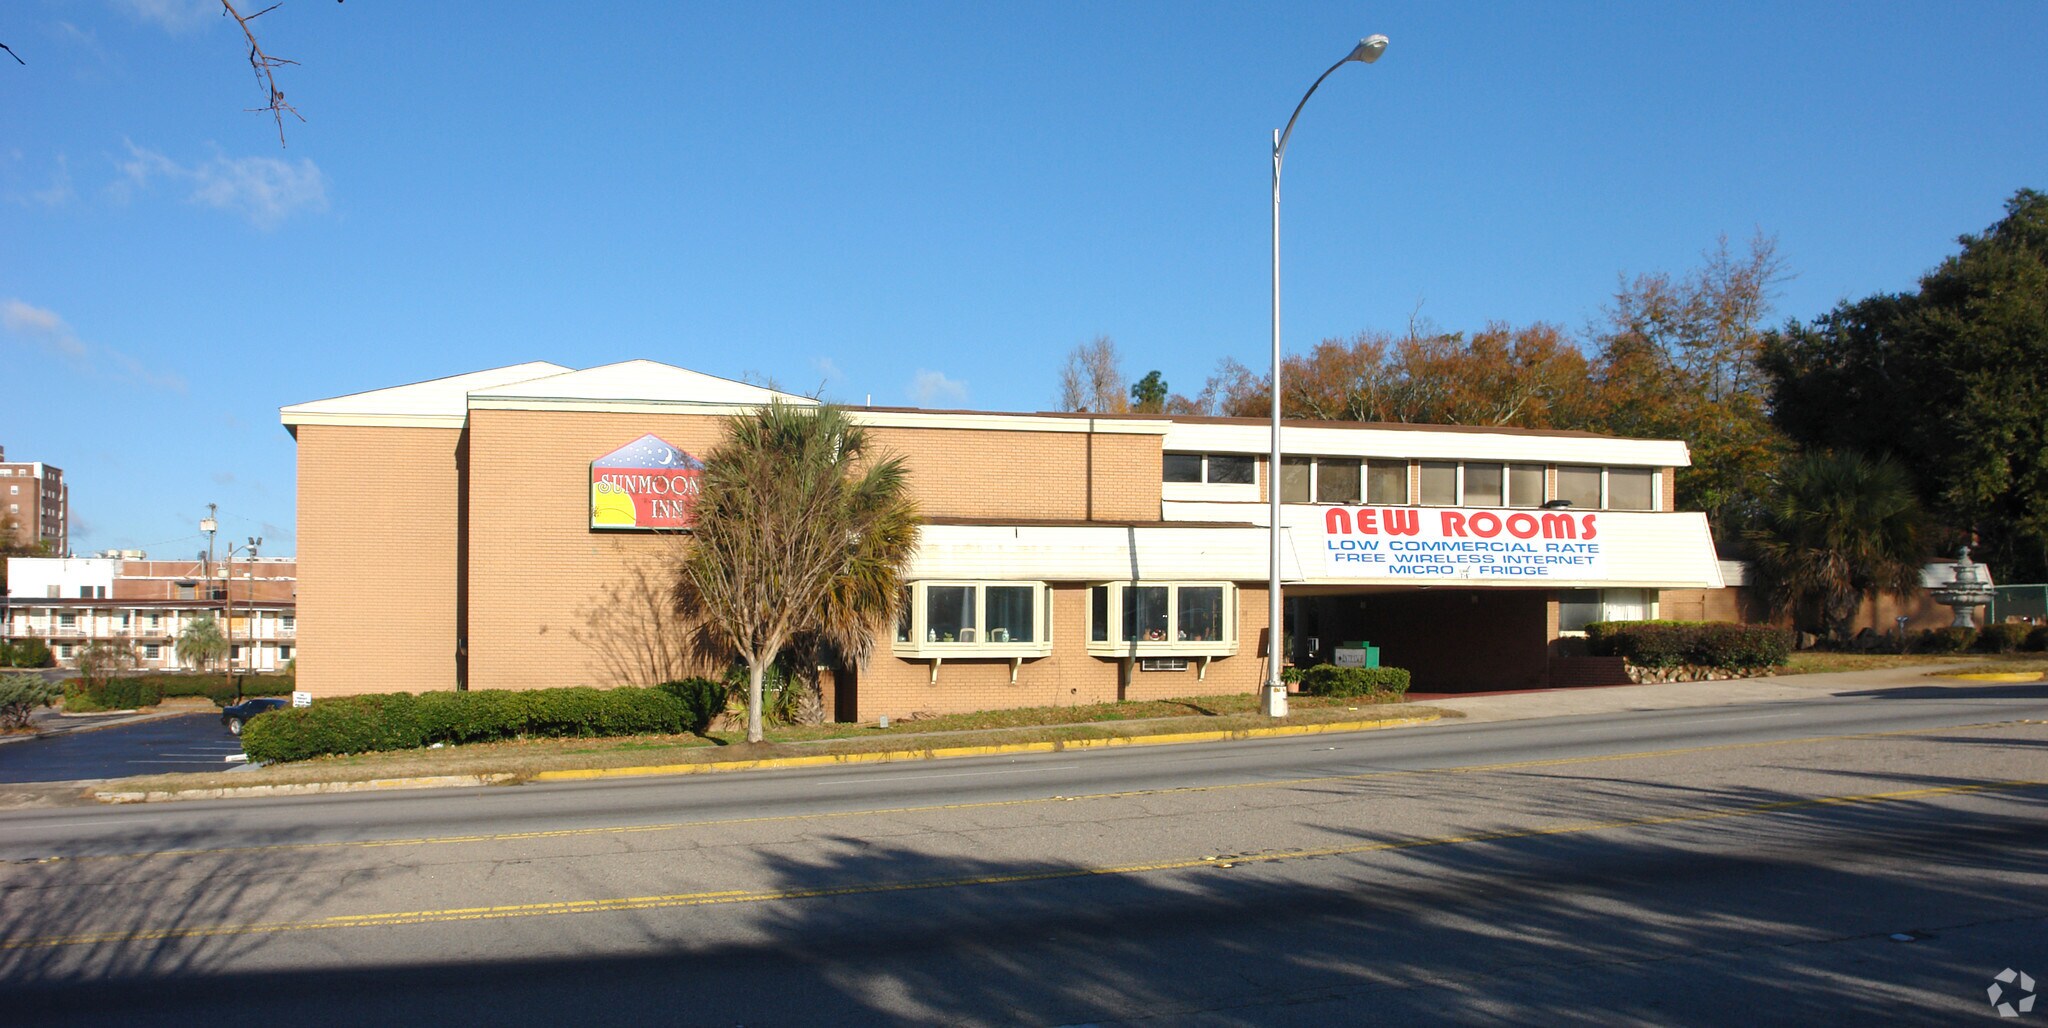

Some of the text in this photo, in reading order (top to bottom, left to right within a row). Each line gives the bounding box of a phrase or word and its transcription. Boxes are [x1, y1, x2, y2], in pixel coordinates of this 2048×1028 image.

[598, 473, 700, 495] SUNMOON
[651, 499, 684, 519] INN
[1325, 507, 1597, 540] NEW ROOMS
[1327, 540, 1600, 553] LOW COMMERCIAL RATE
[1335, 553, 1595, 565] FREE WIRELESS INTERNET
[1389, 565, 1549, 575] MICRO FRIDGE
